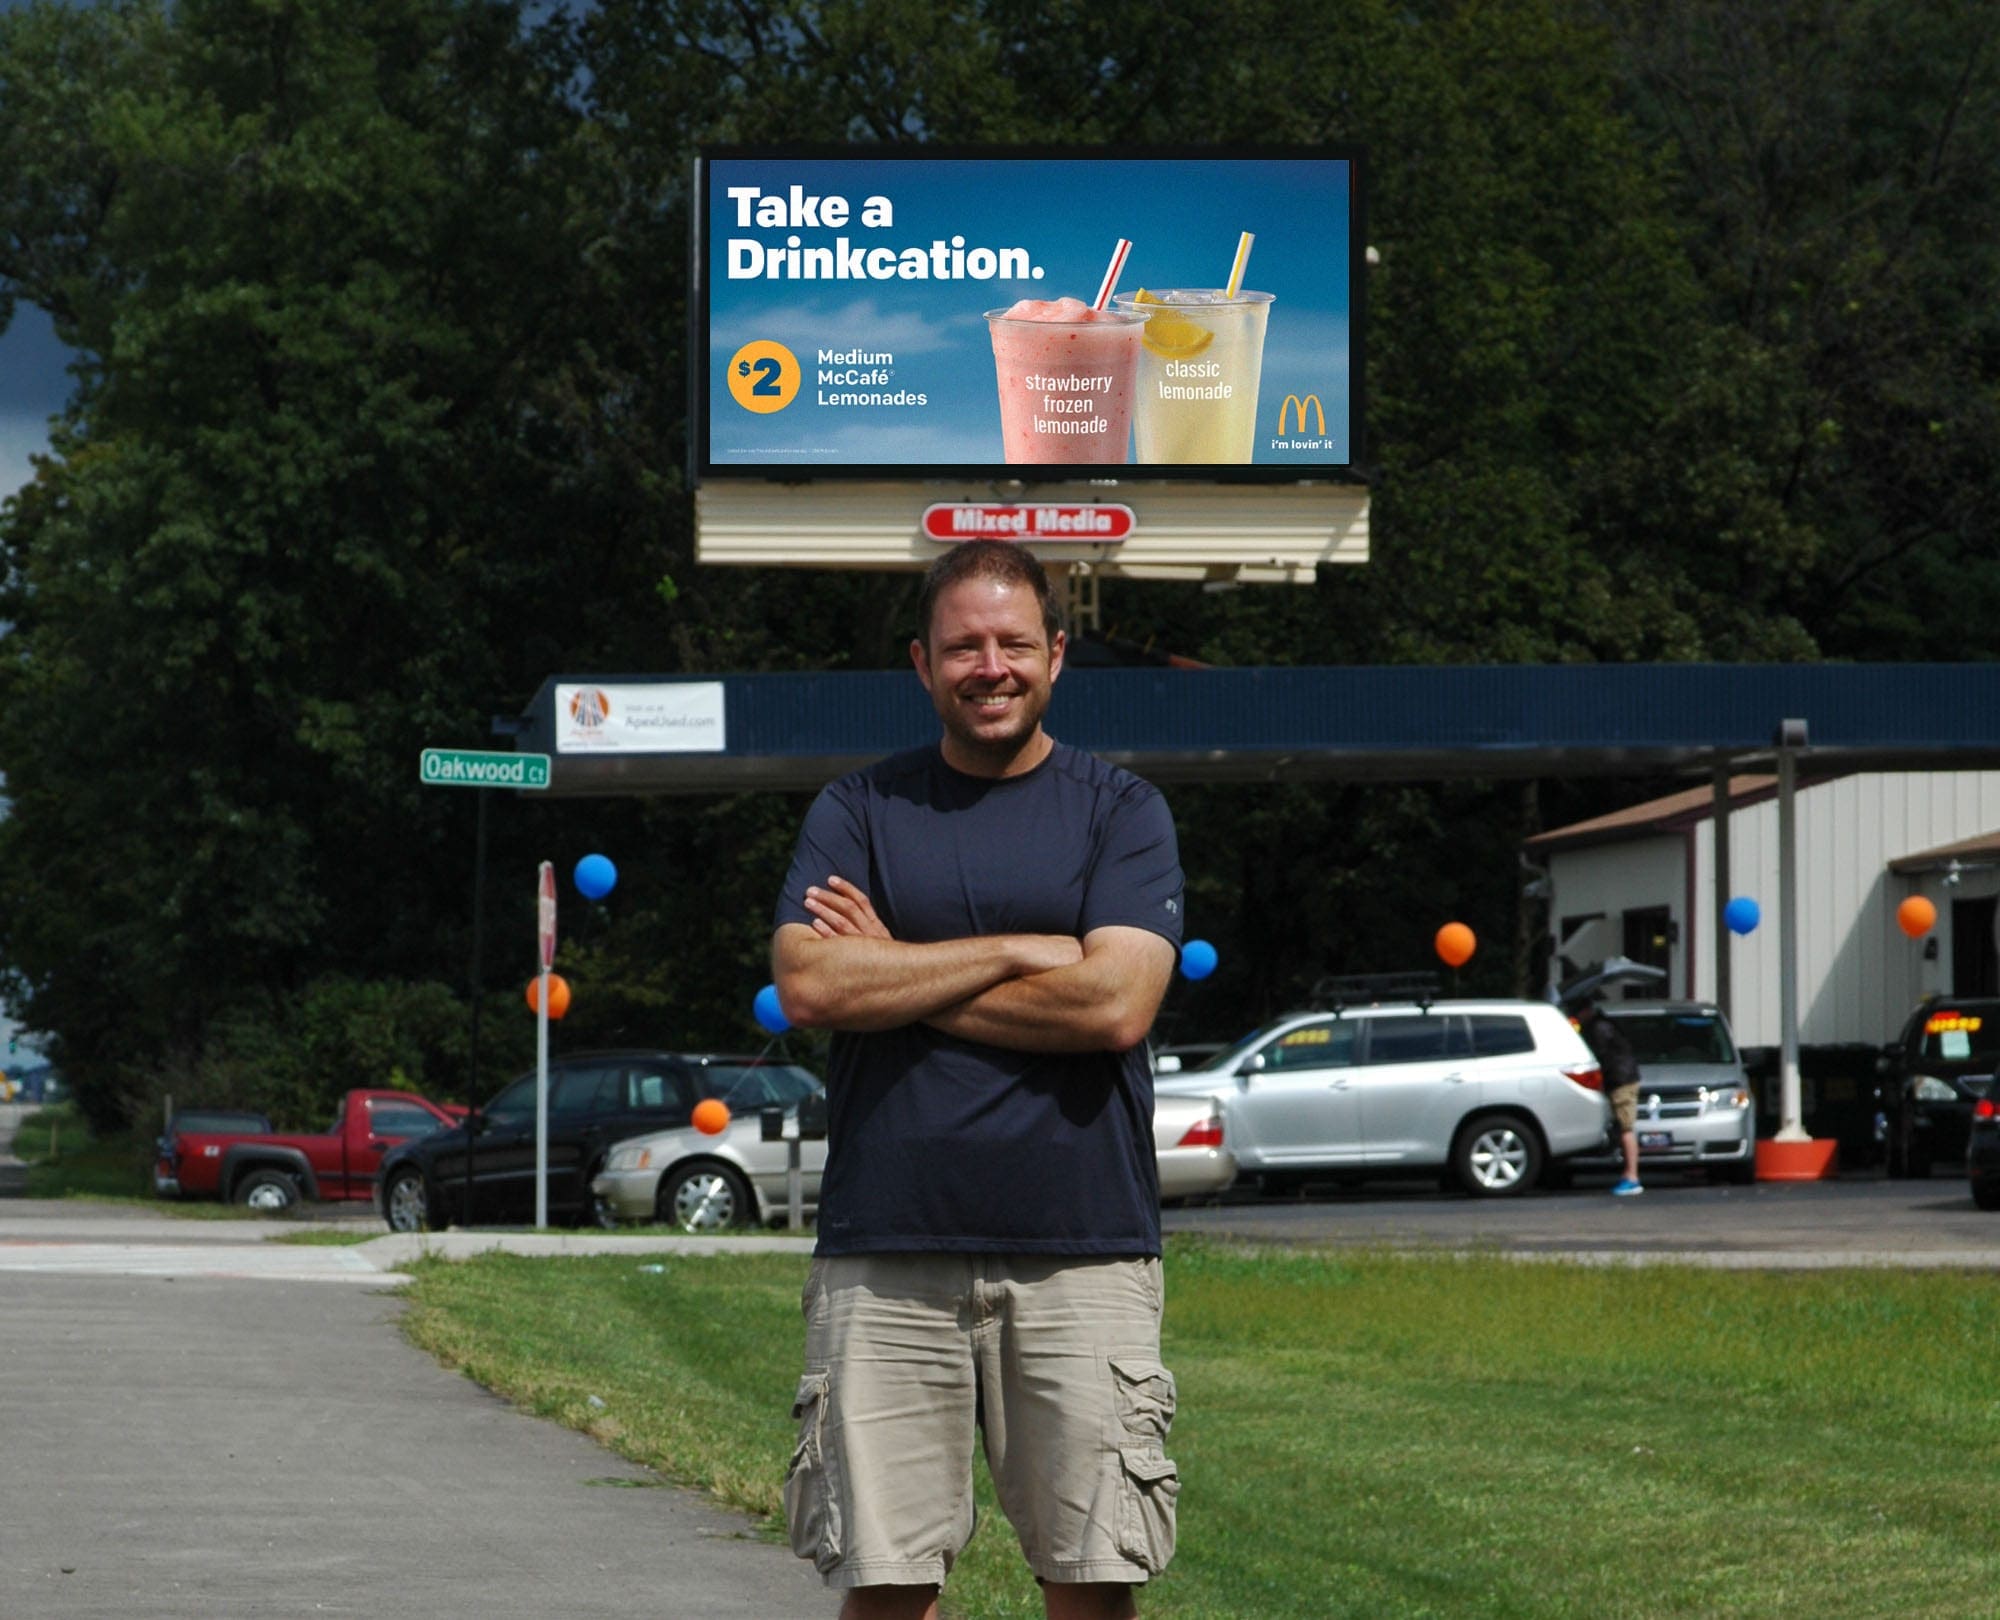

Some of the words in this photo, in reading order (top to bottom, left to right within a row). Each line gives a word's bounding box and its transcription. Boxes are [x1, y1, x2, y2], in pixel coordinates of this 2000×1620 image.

[728, 185, 849, 227] Take
[861, 195, 893, 227] a
[728, 235, 1045, 279] Drinkcation.
[818, 349, 893, 365] Medium
[738, 357, 782, 396] $2
[1166, 360, 1220, 377] classic
[1025, 374, 1113, 393] strawberry
[1159, 381, 1232, 400] lemonade
[818, 390, 928, 406] Lemonades
[1043, 395, 1093, 413] frozen
[1034, 415, 1108, 434] lemonade
[1271, 440, 1289, 450] i'm
[1291, 440, 1322, 450] lovin'
[1324, 440, 1333, 450] it
[953, 508, 1027, 532] Mixed
[1035, 508, 1112, 532] Media
[426, 754, 524, 782] Oakwood
